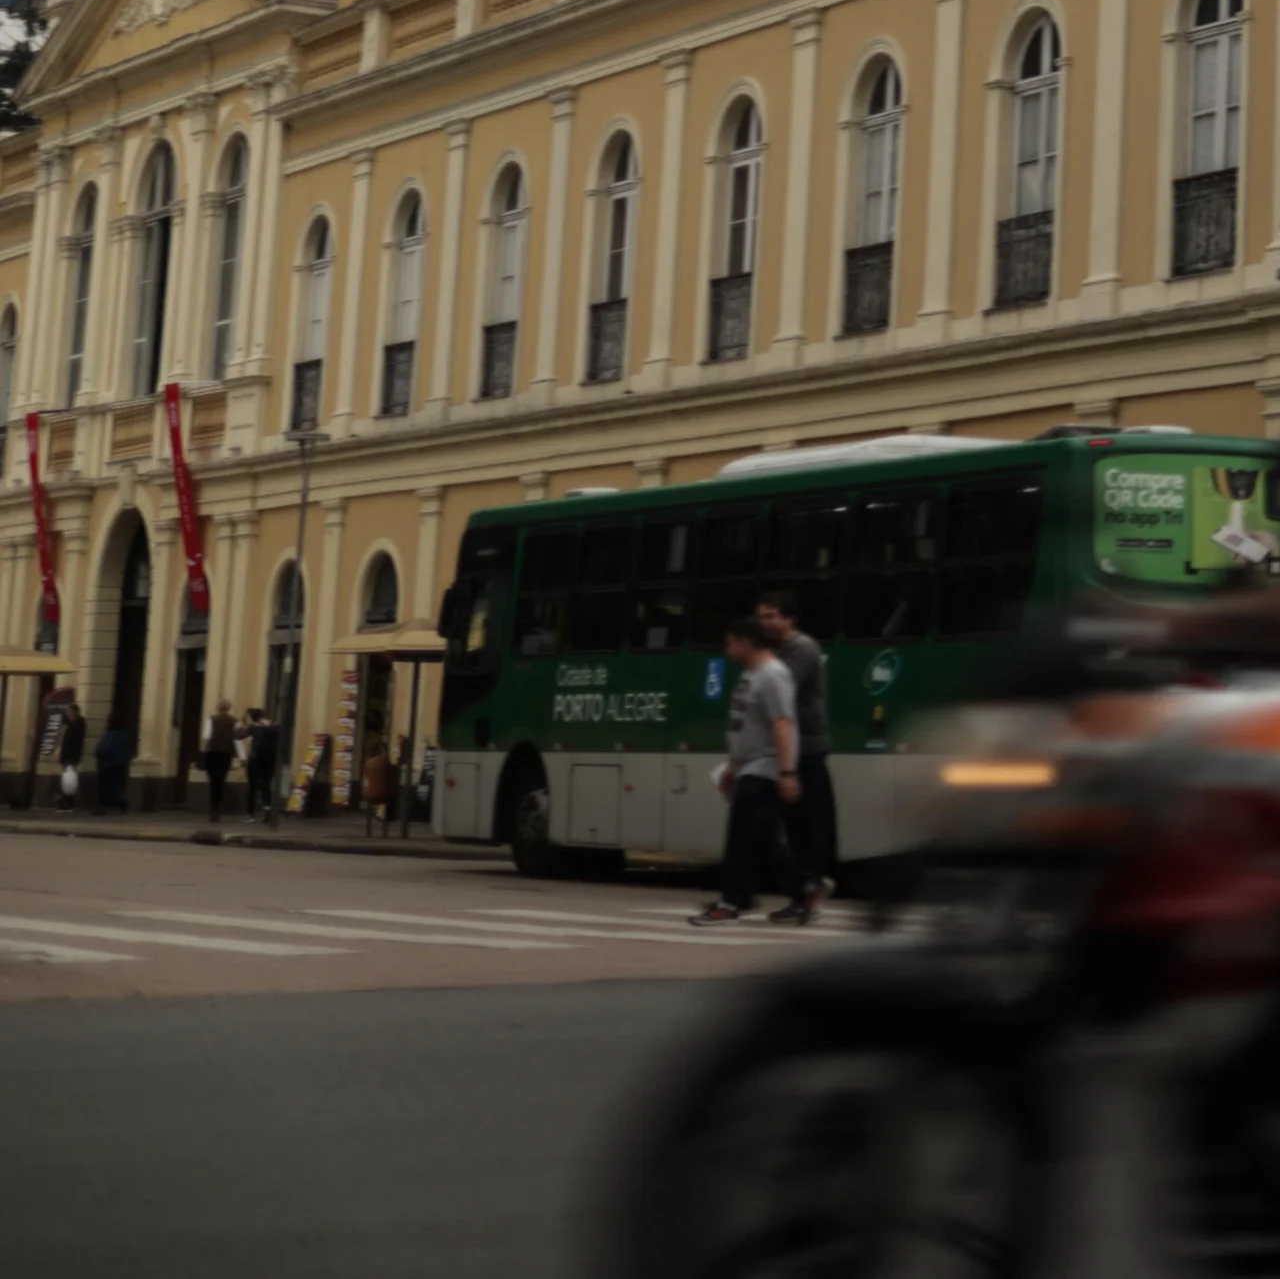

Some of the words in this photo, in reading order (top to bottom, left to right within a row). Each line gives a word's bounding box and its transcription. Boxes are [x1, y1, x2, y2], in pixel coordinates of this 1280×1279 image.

[1105, 468, 1185, 490] Compre
[1105, 489, 1132, 510] QR
[1138, 490, 1185, 508] Code
[1105, 512, 1126, 523] no
[1129, 512, 1161, 527] app
[557, 663, 592, 686] Cidade
[594, 663, 609, 685] de
[552, 693, 604, 722] PORTO
[607, 693, 668, 722] ALEGRE
